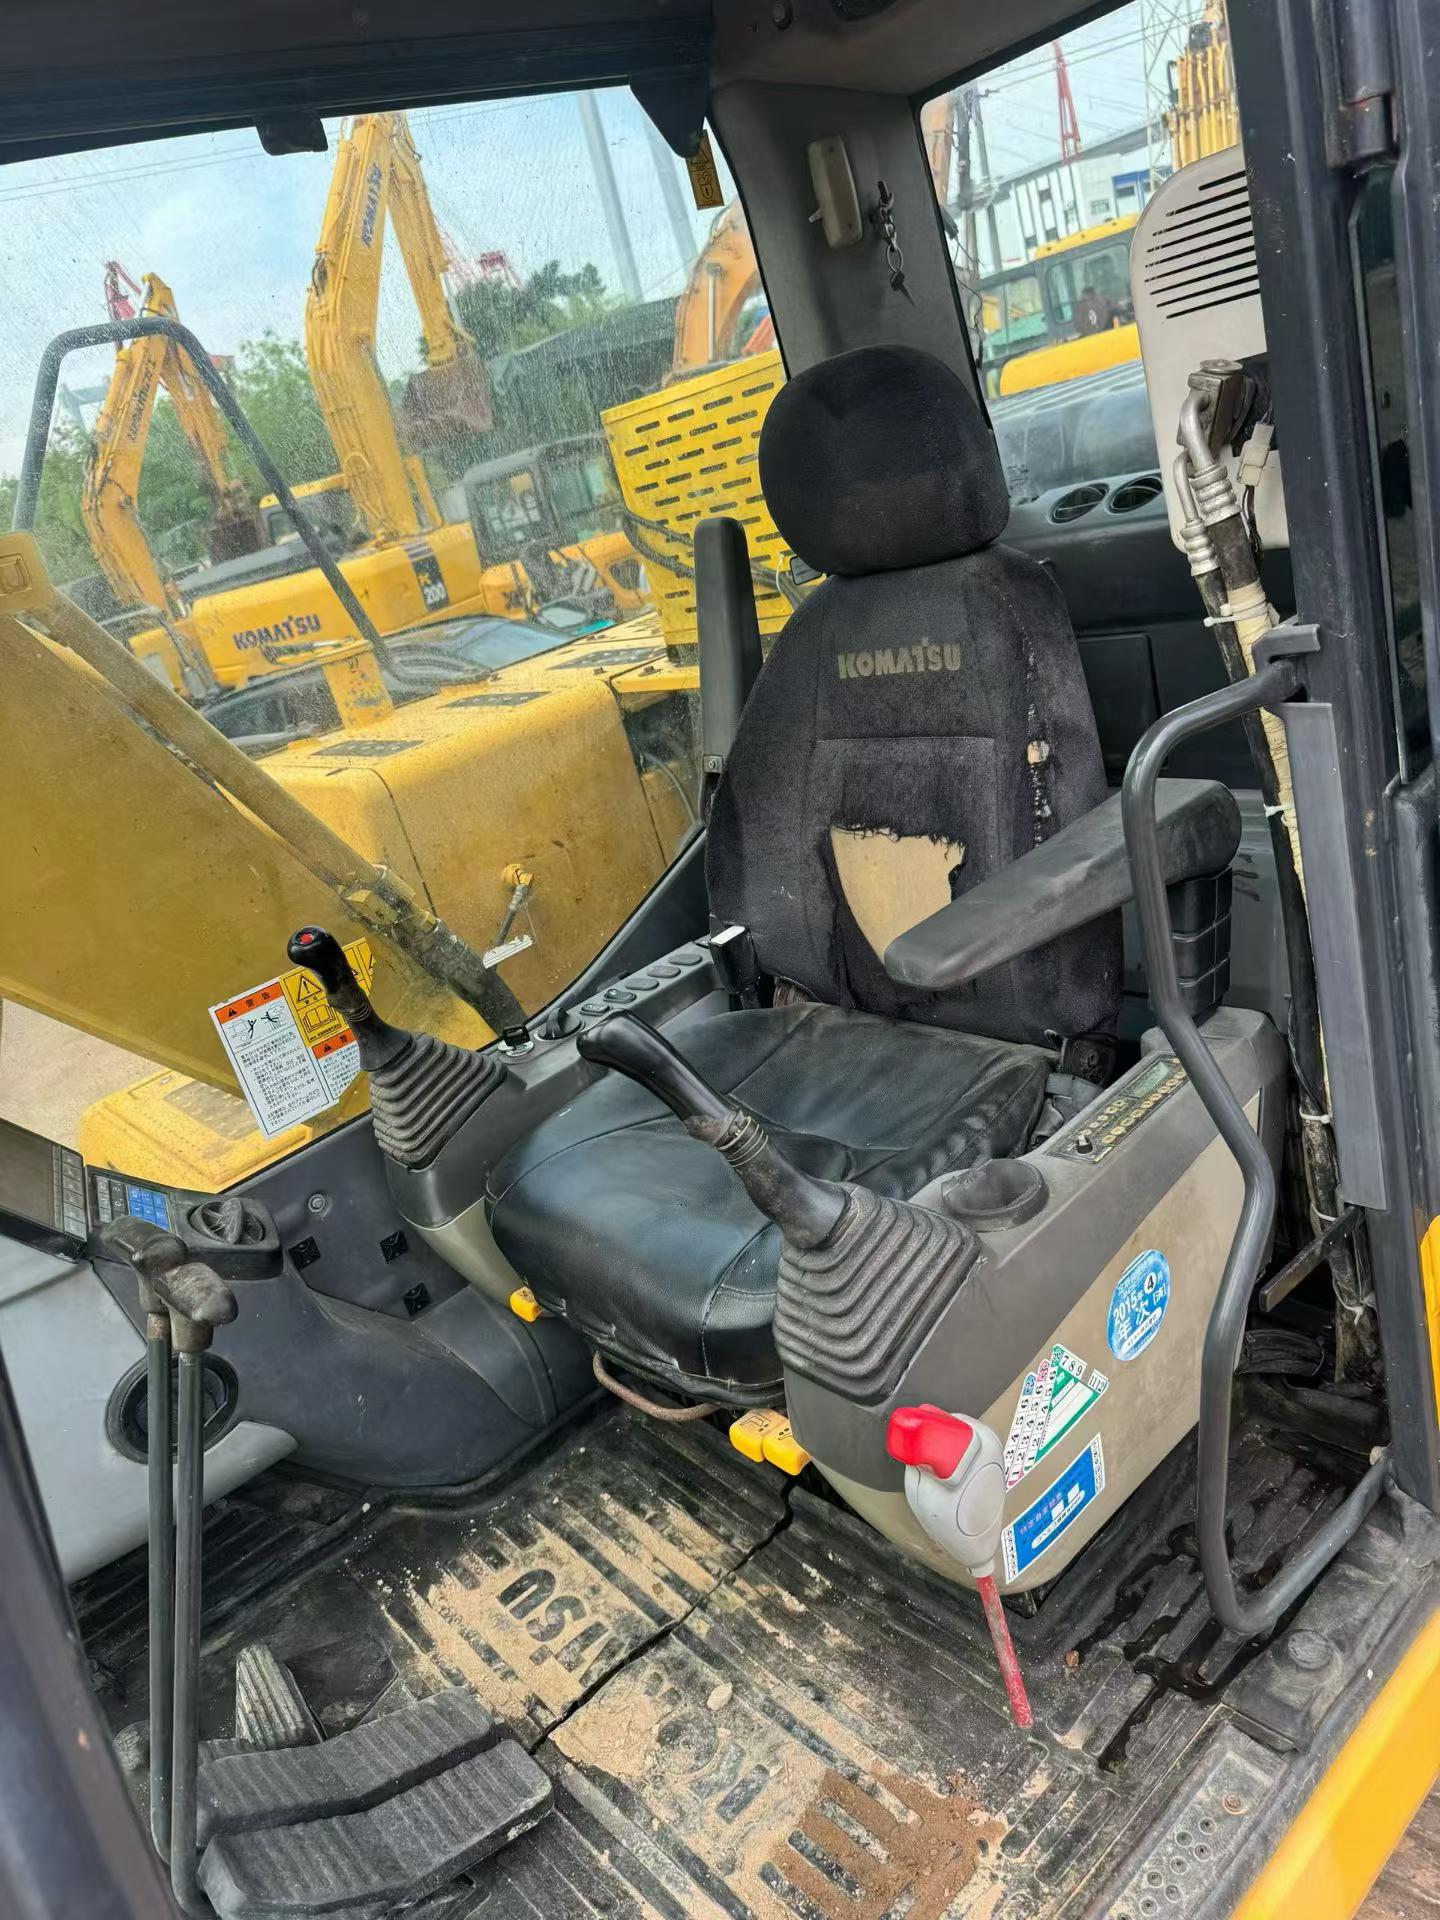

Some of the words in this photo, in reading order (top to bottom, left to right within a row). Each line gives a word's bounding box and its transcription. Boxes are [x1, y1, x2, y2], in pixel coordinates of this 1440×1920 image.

[424, 582, 446, 604] 200
[233, 614, 321, 650] KOMATSU
[837, 637, 960, 679] KOMATSU
